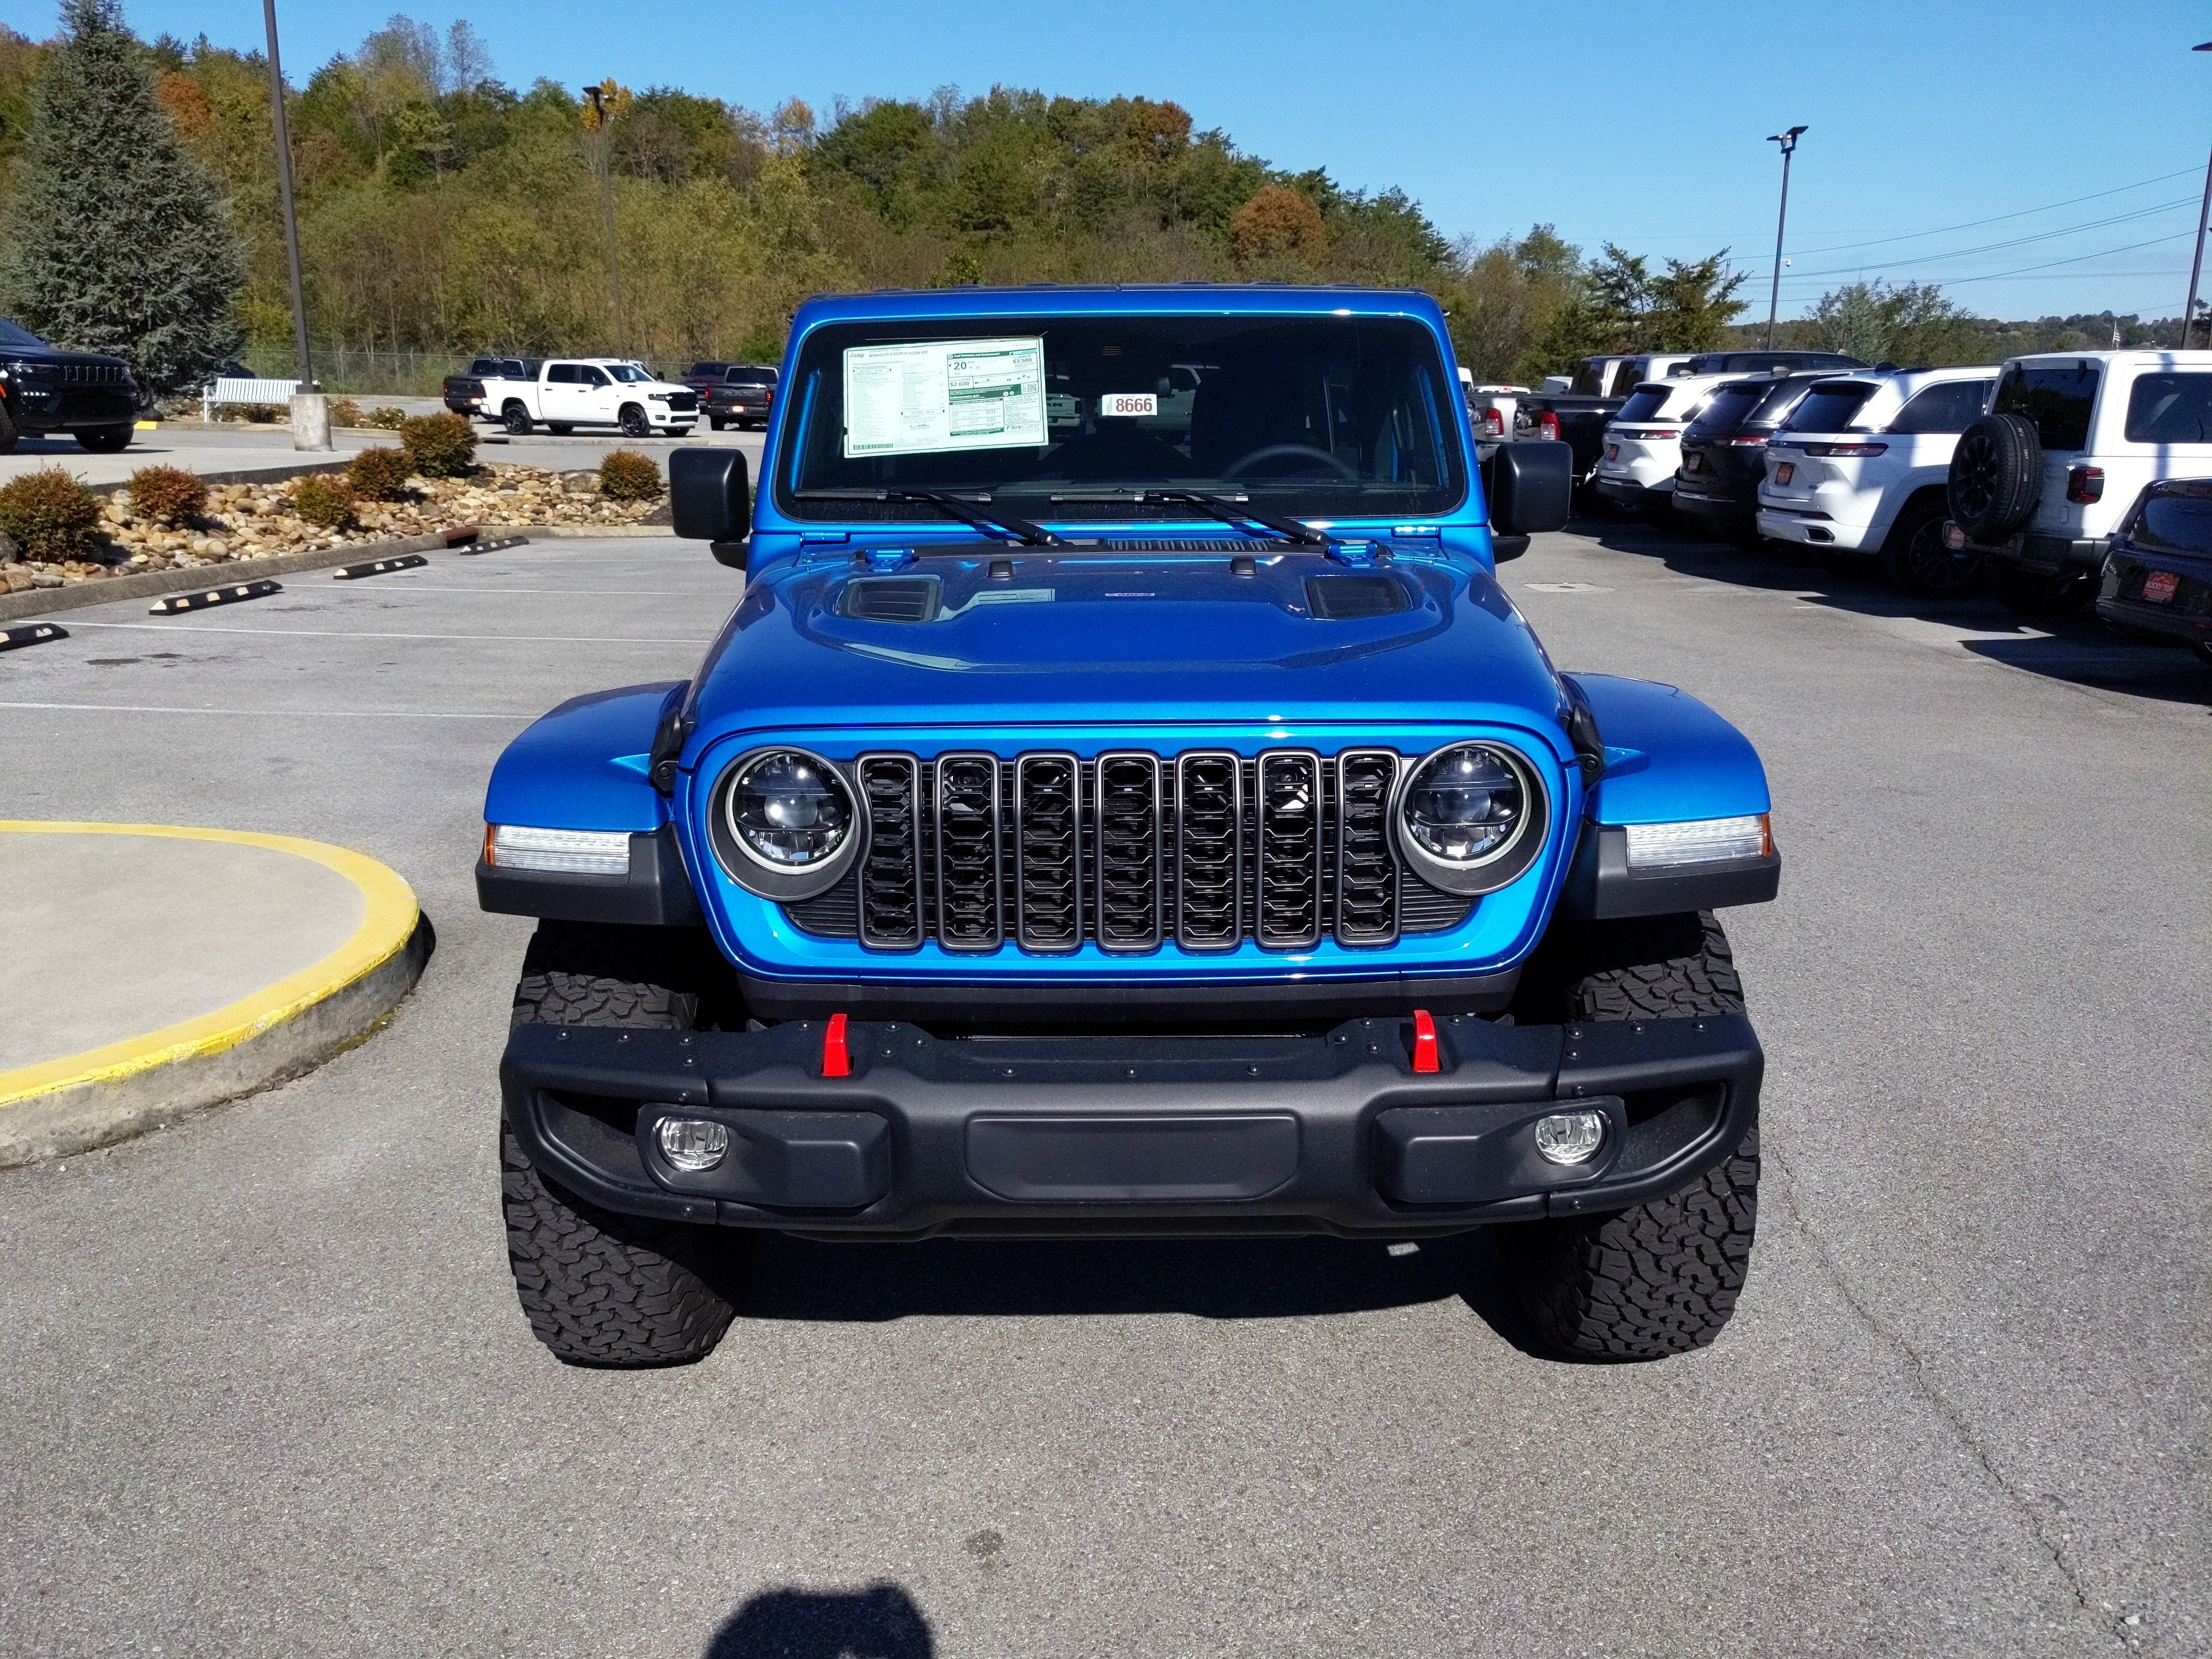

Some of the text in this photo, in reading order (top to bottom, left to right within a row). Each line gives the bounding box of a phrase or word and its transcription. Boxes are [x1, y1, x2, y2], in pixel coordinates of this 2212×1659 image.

[954, 362, 966, 370] 20
[1116, 398, 1153, 412] 8666
[2145, 581, 2174, 592] ROCKY TOP
